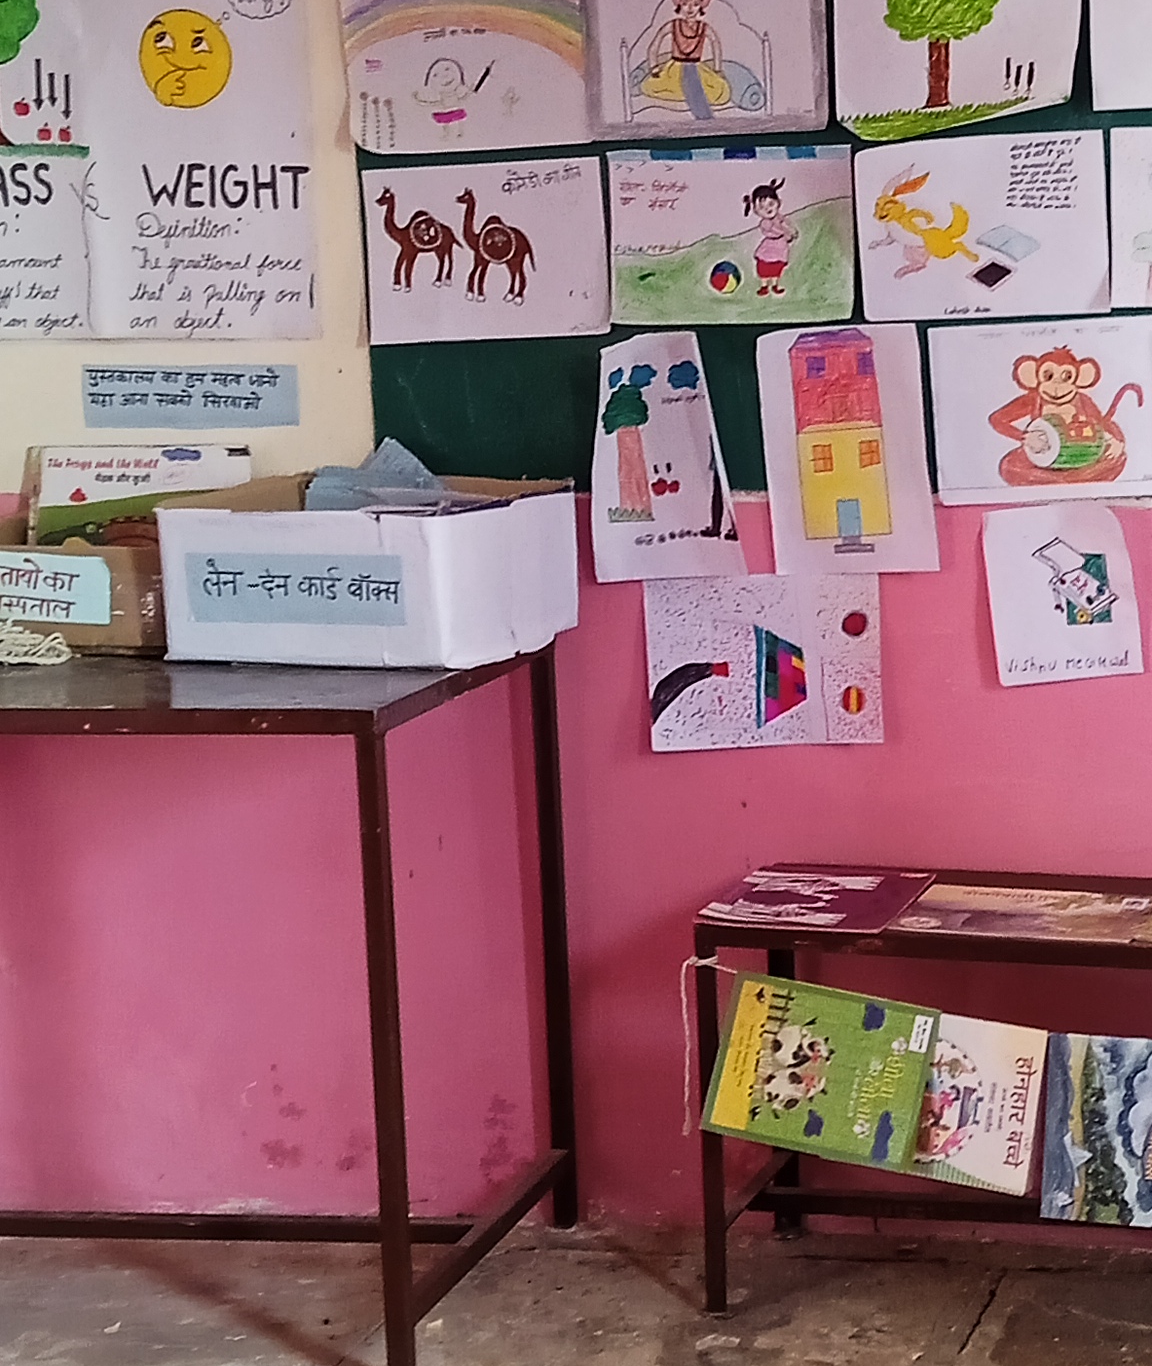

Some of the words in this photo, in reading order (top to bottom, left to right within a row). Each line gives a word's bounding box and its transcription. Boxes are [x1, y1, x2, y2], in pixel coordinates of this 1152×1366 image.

[142, 163, 311, 210] WEIGHT
[257, 254, 302, 277] force
[129, 283, 164, 300] that
[177, 286, 192, 302] is
[275, 289, 302, 303] on
[130, 316, 157, 328] an
[86, 369, 157, 387] पुस्तकालय
[161, 371, 182, 383] का
[43, 571, 80, 592] का
[298, 566, 343, 602] कार्ड
[1009, 1057, 1038, 1126] होनहार
